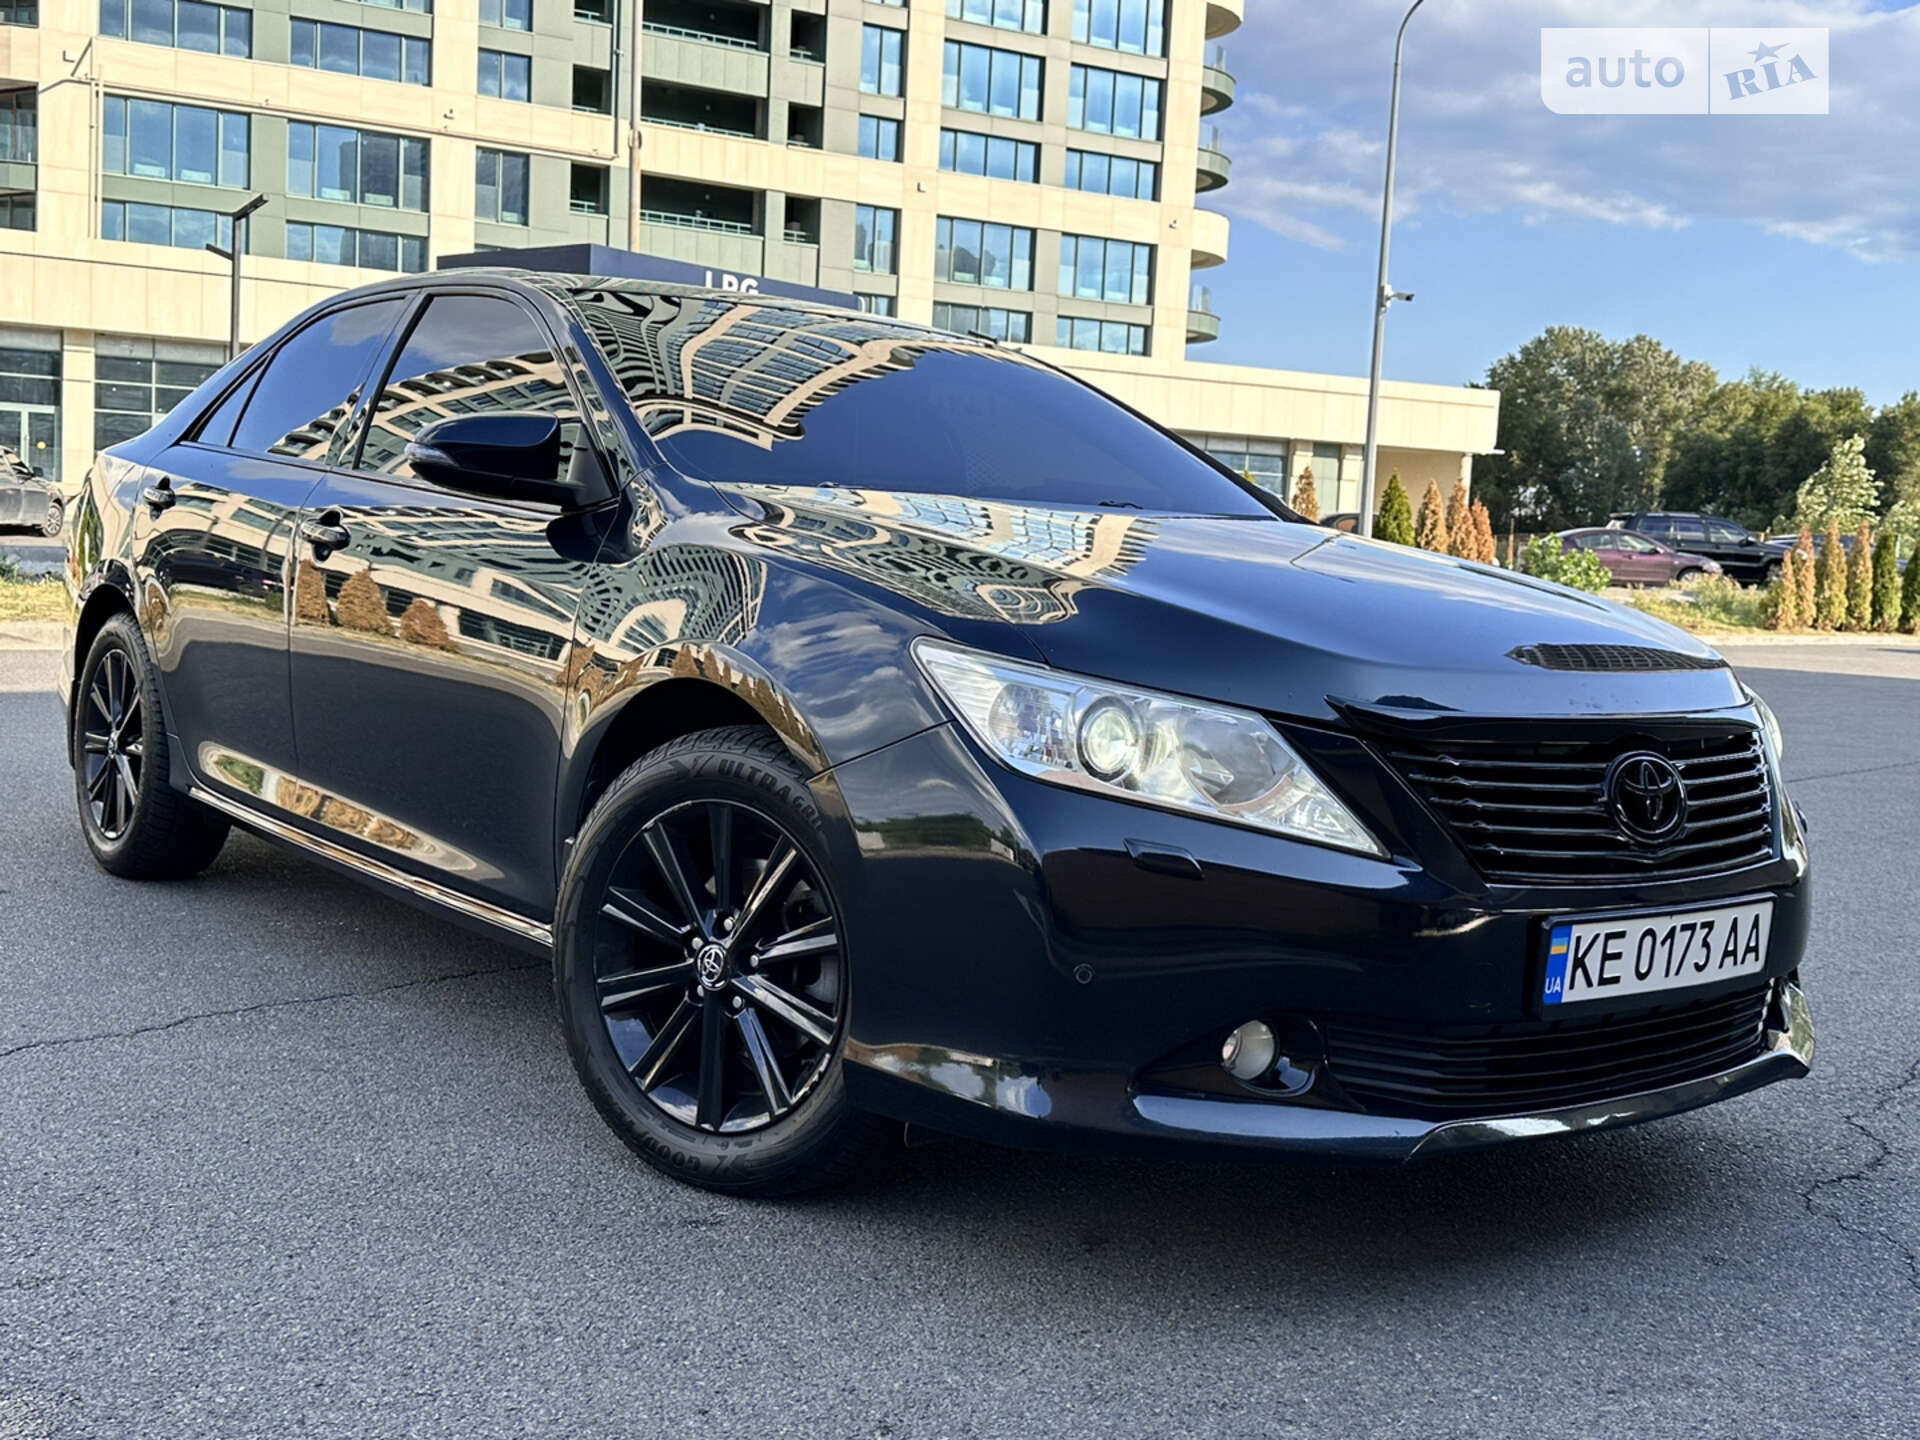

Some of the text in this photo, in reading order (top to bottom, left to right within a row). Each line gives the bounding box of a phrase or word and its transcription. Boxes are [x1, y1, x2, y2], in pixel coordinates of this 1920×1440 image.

[705, 270, 759, 295] LPG
[1568, 913, 1761, 991] KE 0173 AA
[1544, 976, 1562, 994] UA
